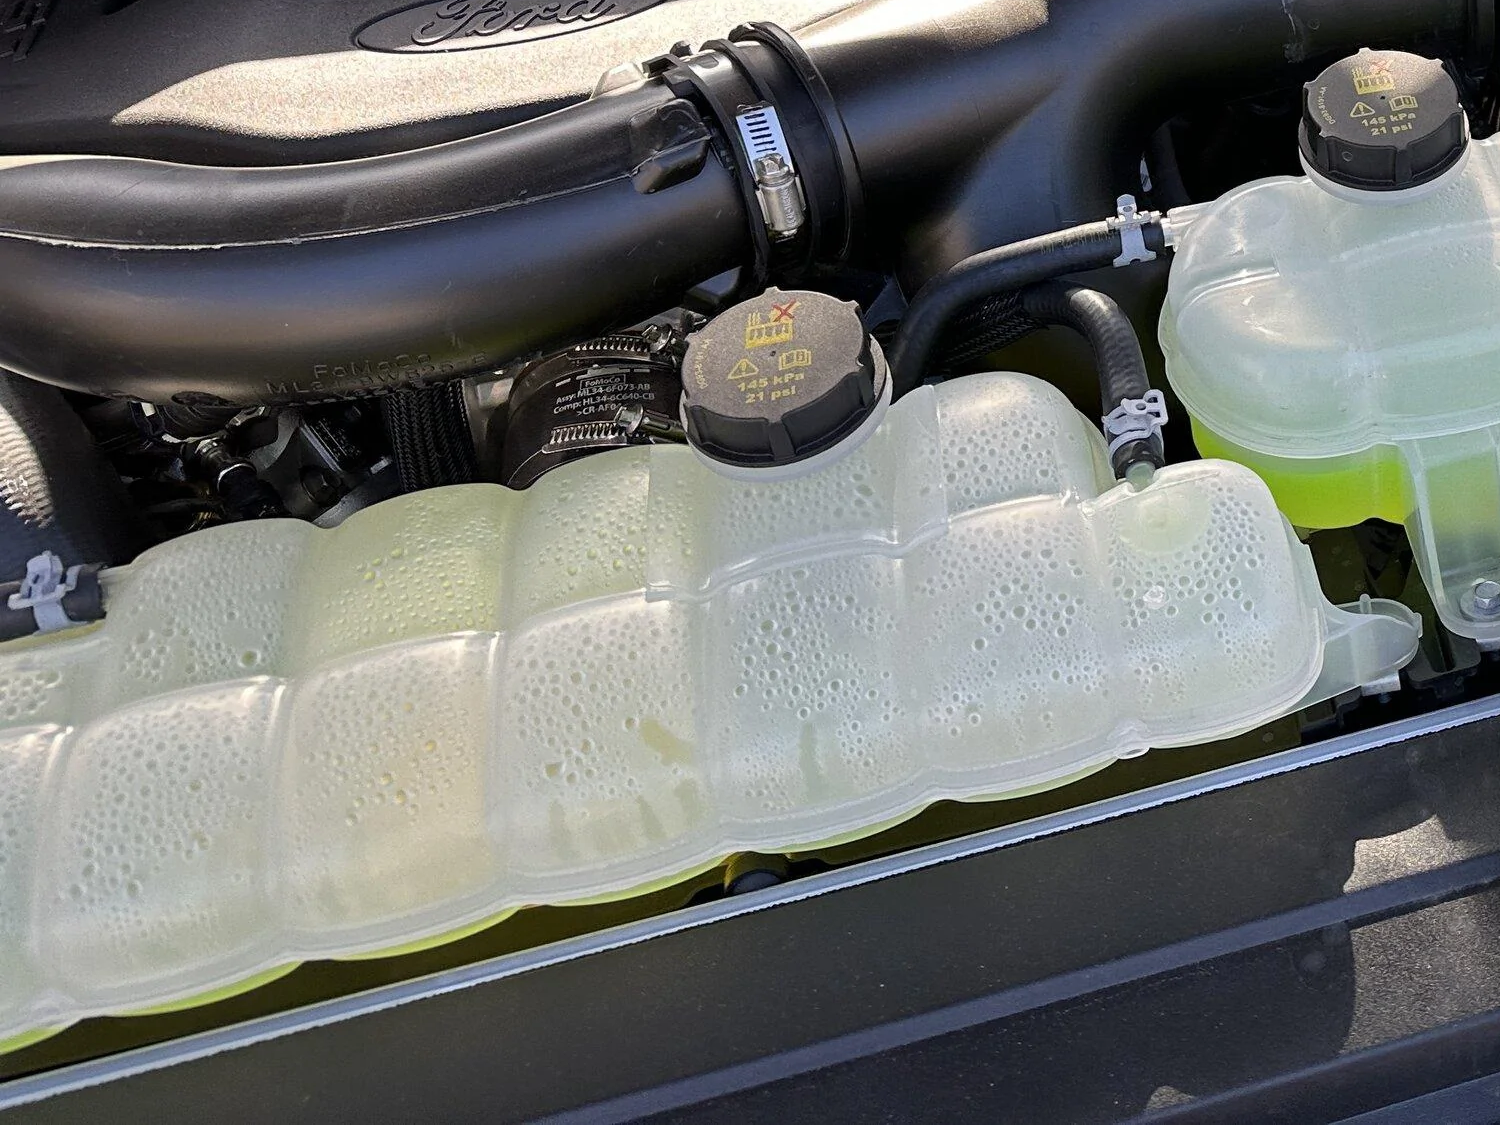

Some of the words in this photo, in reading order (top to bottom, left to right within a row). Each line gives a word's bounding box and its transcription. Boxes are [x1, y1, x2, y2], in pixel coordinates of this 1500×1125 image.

[1361, 116, 1387, 127] 145
[1389, 112, 1417, 123] kPa
[1370, 127, 1387, 137] 21
[1391, 122, 1414, 134] psi
[584, 376, 621, 388] FoMoCo
[737, 378, 769, 393] 145
[773, 372, 805, 387] kPa
[745, 392, 765, 405] 21
[771, 385, 797, 402] psi
